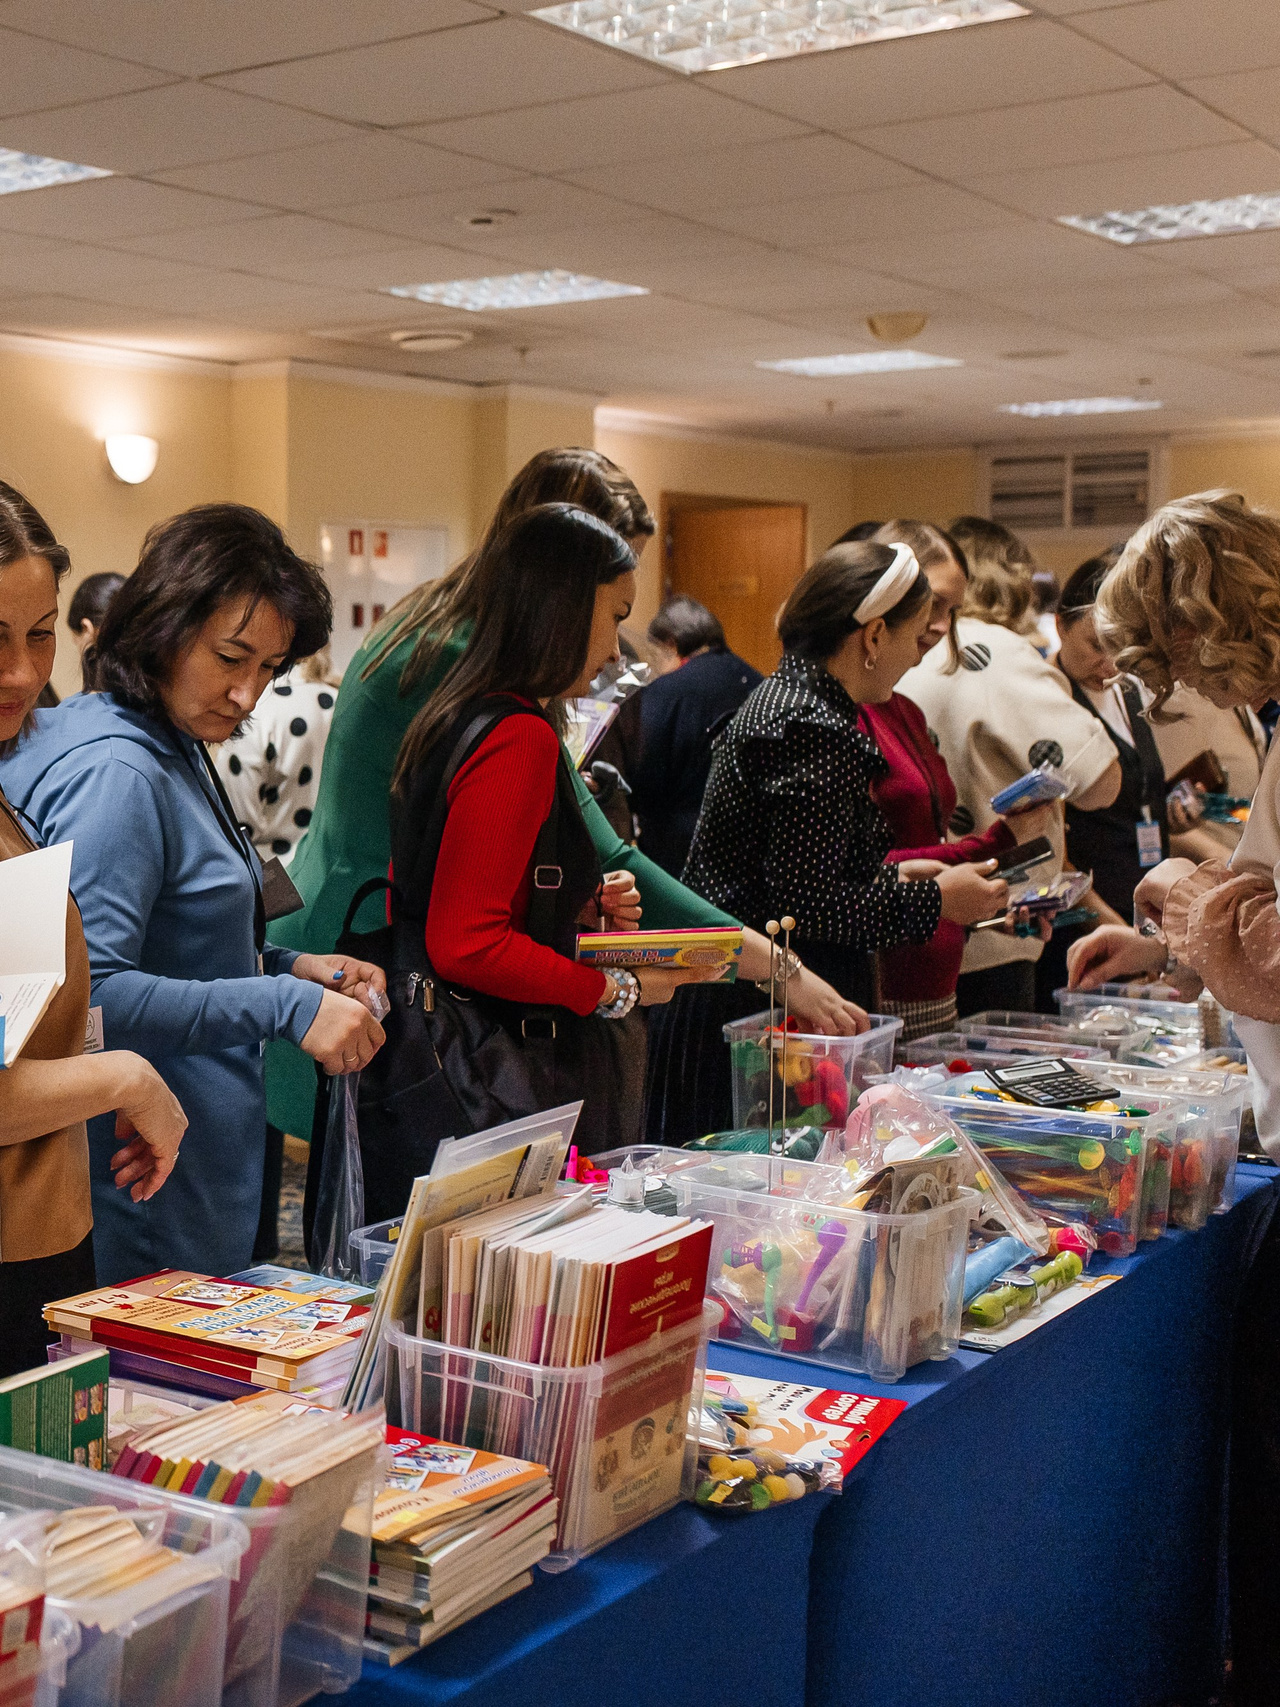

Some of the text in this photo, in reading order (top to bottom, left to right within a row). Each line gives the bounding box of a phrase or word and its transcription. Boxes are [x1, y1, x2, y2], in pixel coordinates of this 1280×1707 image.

[195, 1298, 297, 1332] ЗАКРЕПЛЯЕМ
[229, 1294, 286, 1313] ЗВУКИ
[172, 1313, 219, 1330] РЕЧИ
[821, 1392, 860, 1422] СОРТЕР
[841, 1397, 881, 1426] УМНЫЙ
